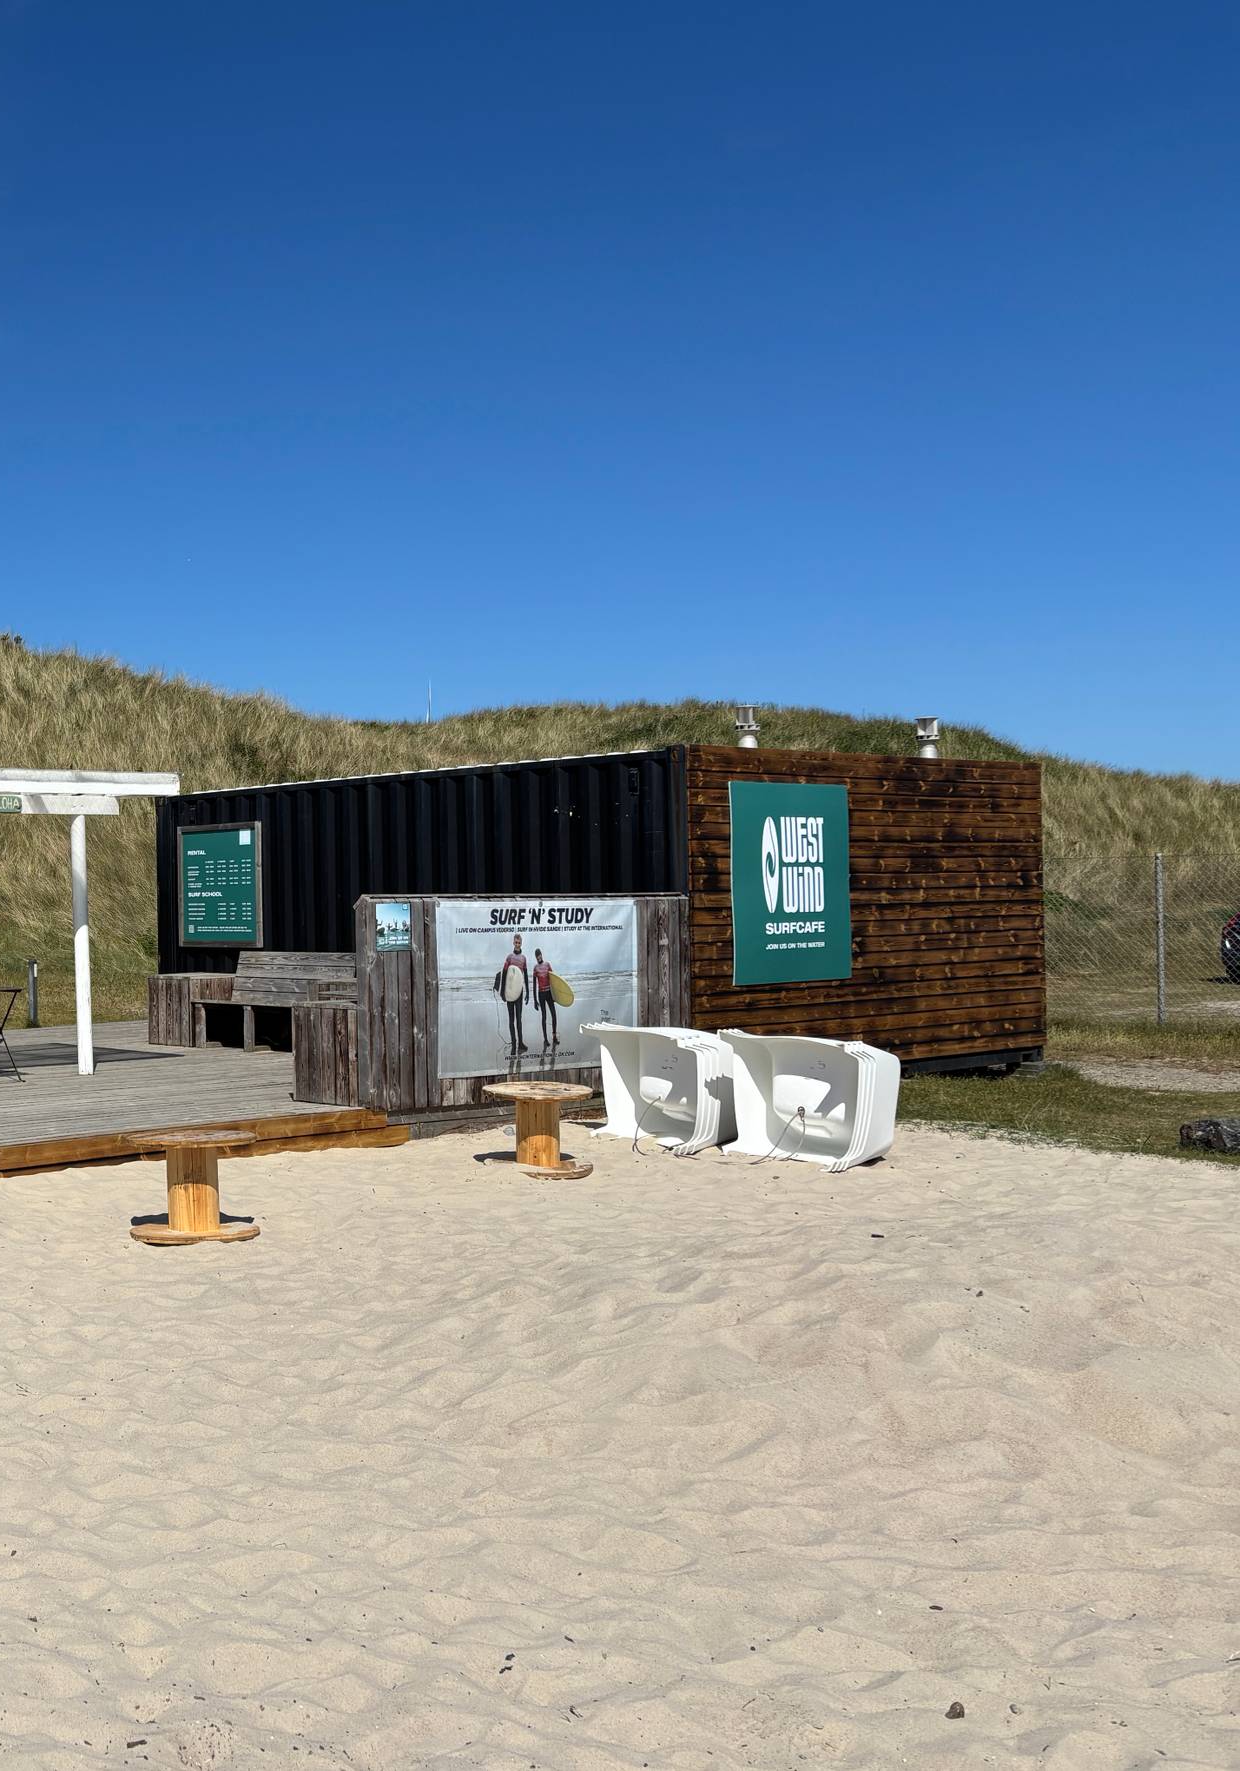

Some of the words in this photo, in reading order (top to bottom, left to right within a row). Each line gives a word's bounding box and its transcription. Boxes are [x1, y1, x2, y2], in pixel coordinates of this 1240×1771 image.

[780, 816, 824, 863] WEST
[489, 908, 526, 925] SURF
[528, 908, 545, 925] 'N'
[547, 907, 594, 925] STUDY
[765, 921, 826, 935] SURFCAFE
